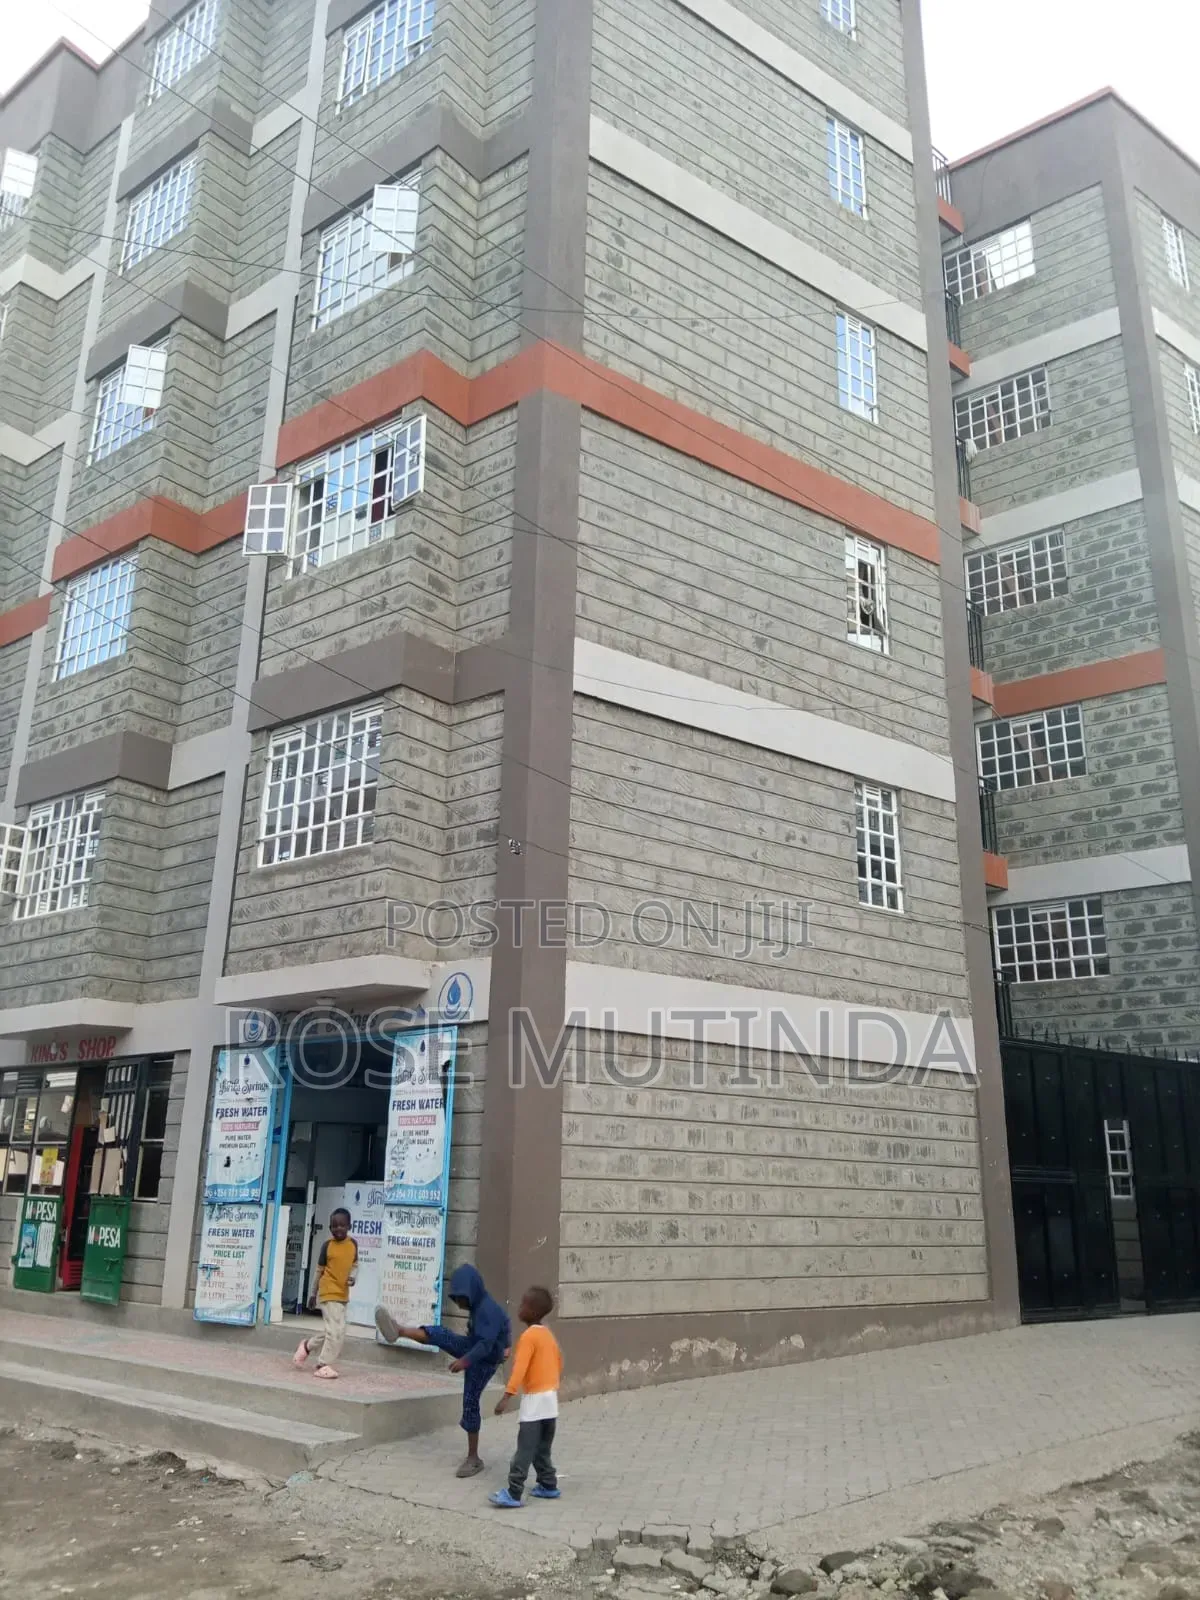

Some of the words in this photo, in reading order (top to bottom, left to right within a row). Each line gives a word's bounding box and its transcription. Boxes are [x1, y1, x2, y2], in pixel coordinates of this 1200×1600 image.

[242, 1078, 269, 1096] Springs
[392, 1099, 417, 1111] FRESH
[215, 1107, 240, 1119] FRESH
[241, 1106, 268, 1117] WATER
[208, 1228, 230, 1238] FRESH
[231, 1228, 255, 1238] WATER
[351, 1219, 382, 1235] FRESH
[387, 1236, 410, 1247] FRESH
[412, 1238, 436, 1248] WATER
[213, 1250, 231, 1258] PRICE
[232, 1250, 245, 1259] LIST
[393, 1260, 412, 1270] PRICE
[413, 1262, 427, 1272] LIST
